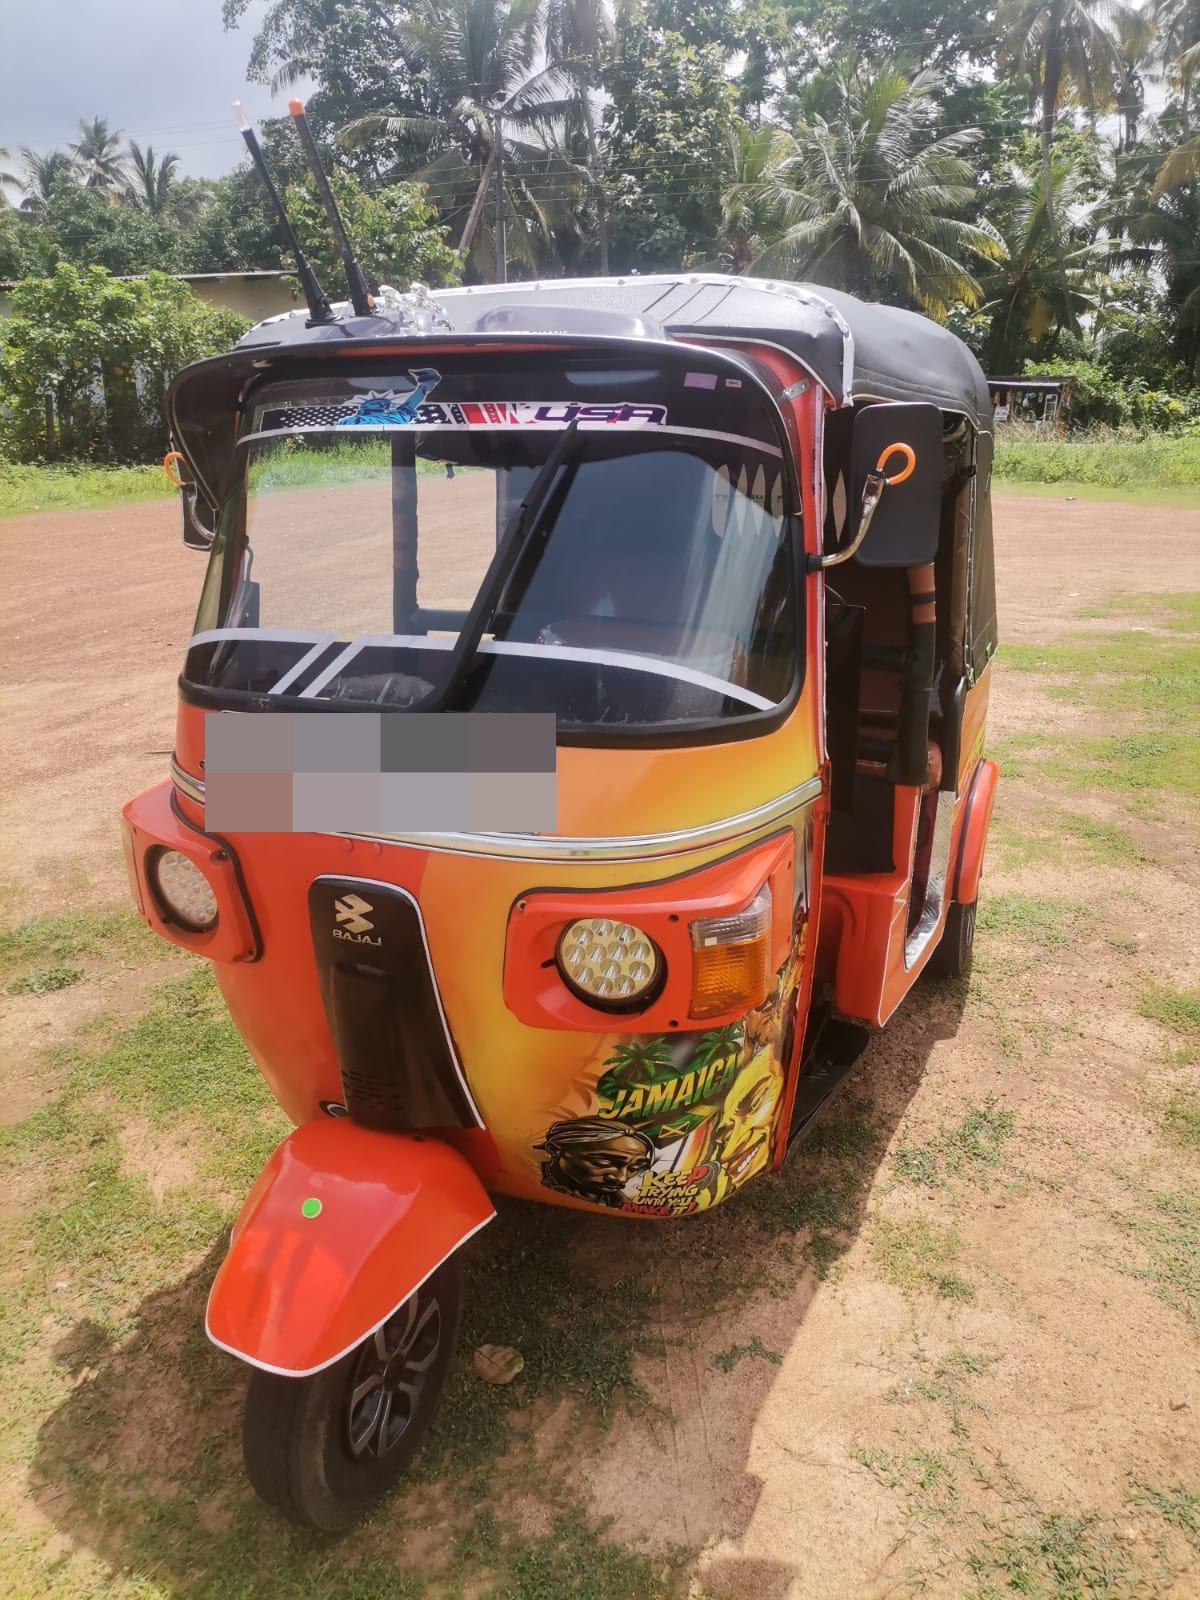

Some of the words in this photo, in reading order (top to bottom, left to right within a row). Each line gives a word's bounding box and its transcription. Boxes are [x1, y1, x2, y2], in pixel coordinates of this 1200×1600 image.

[534, 404, 666, 425] USA
[333, 929, 382, 946] BAJAJ
[598, 1051, 743, 1119] JAMAICA
[642, 1166, 709, 1188] KEEP
[636, 1185, 699, 1199] TRYING
